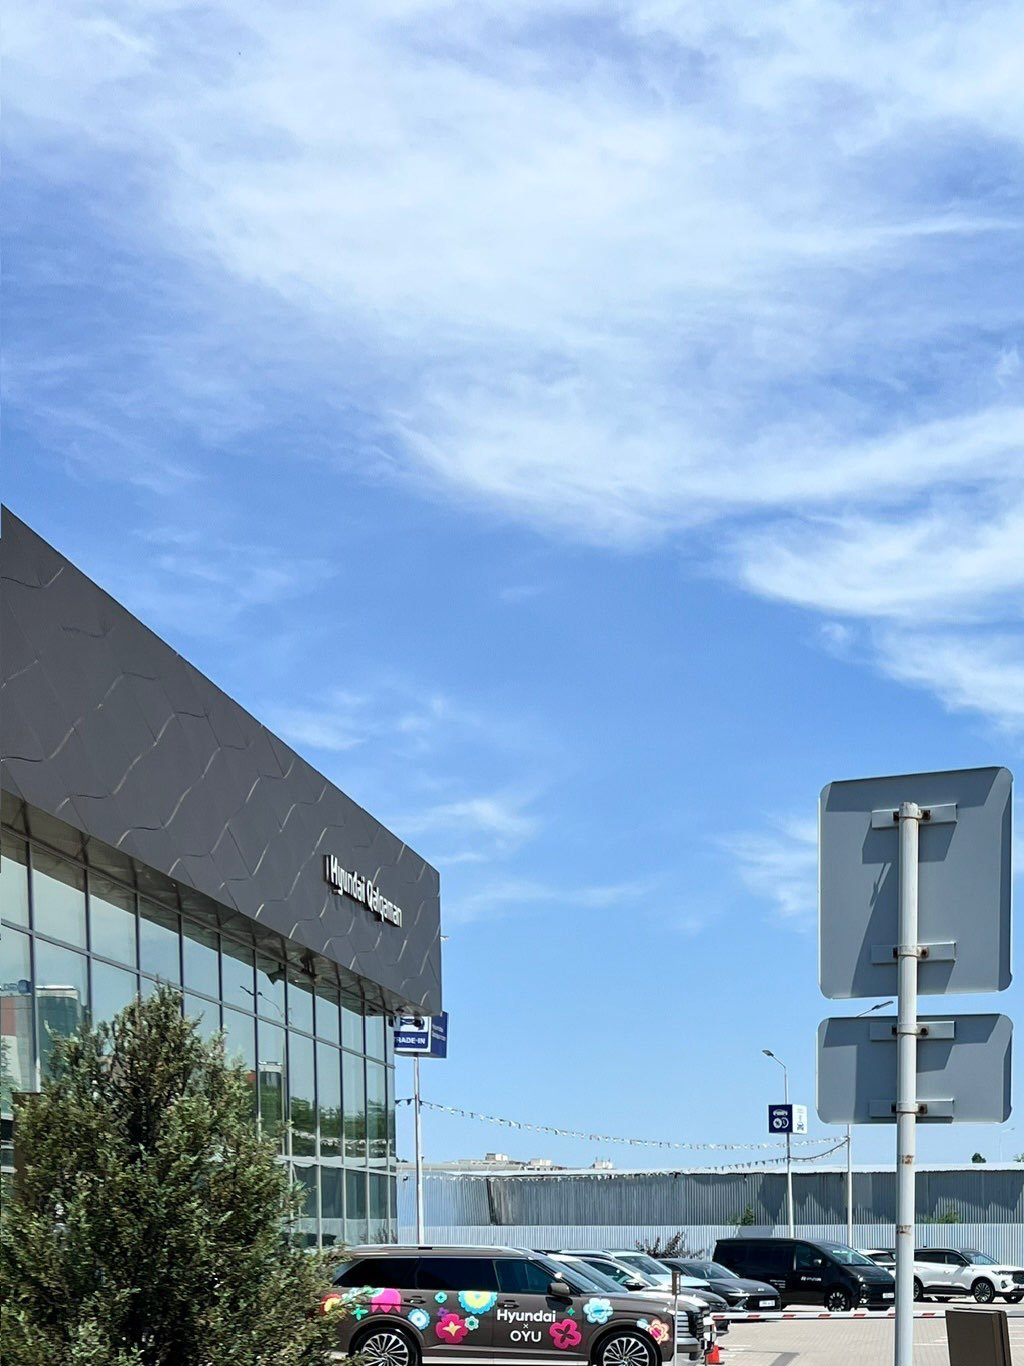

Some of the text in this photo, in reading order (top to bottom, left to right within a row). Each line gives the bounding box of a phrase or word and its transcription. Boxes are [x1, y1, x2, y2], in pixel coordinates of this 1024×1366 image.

[326, 854, 402, 928] Hyundai Qalqaman
[497, 1309, 556, 1323] Hyundai
[510, 1330, 542, 1342] OYU
